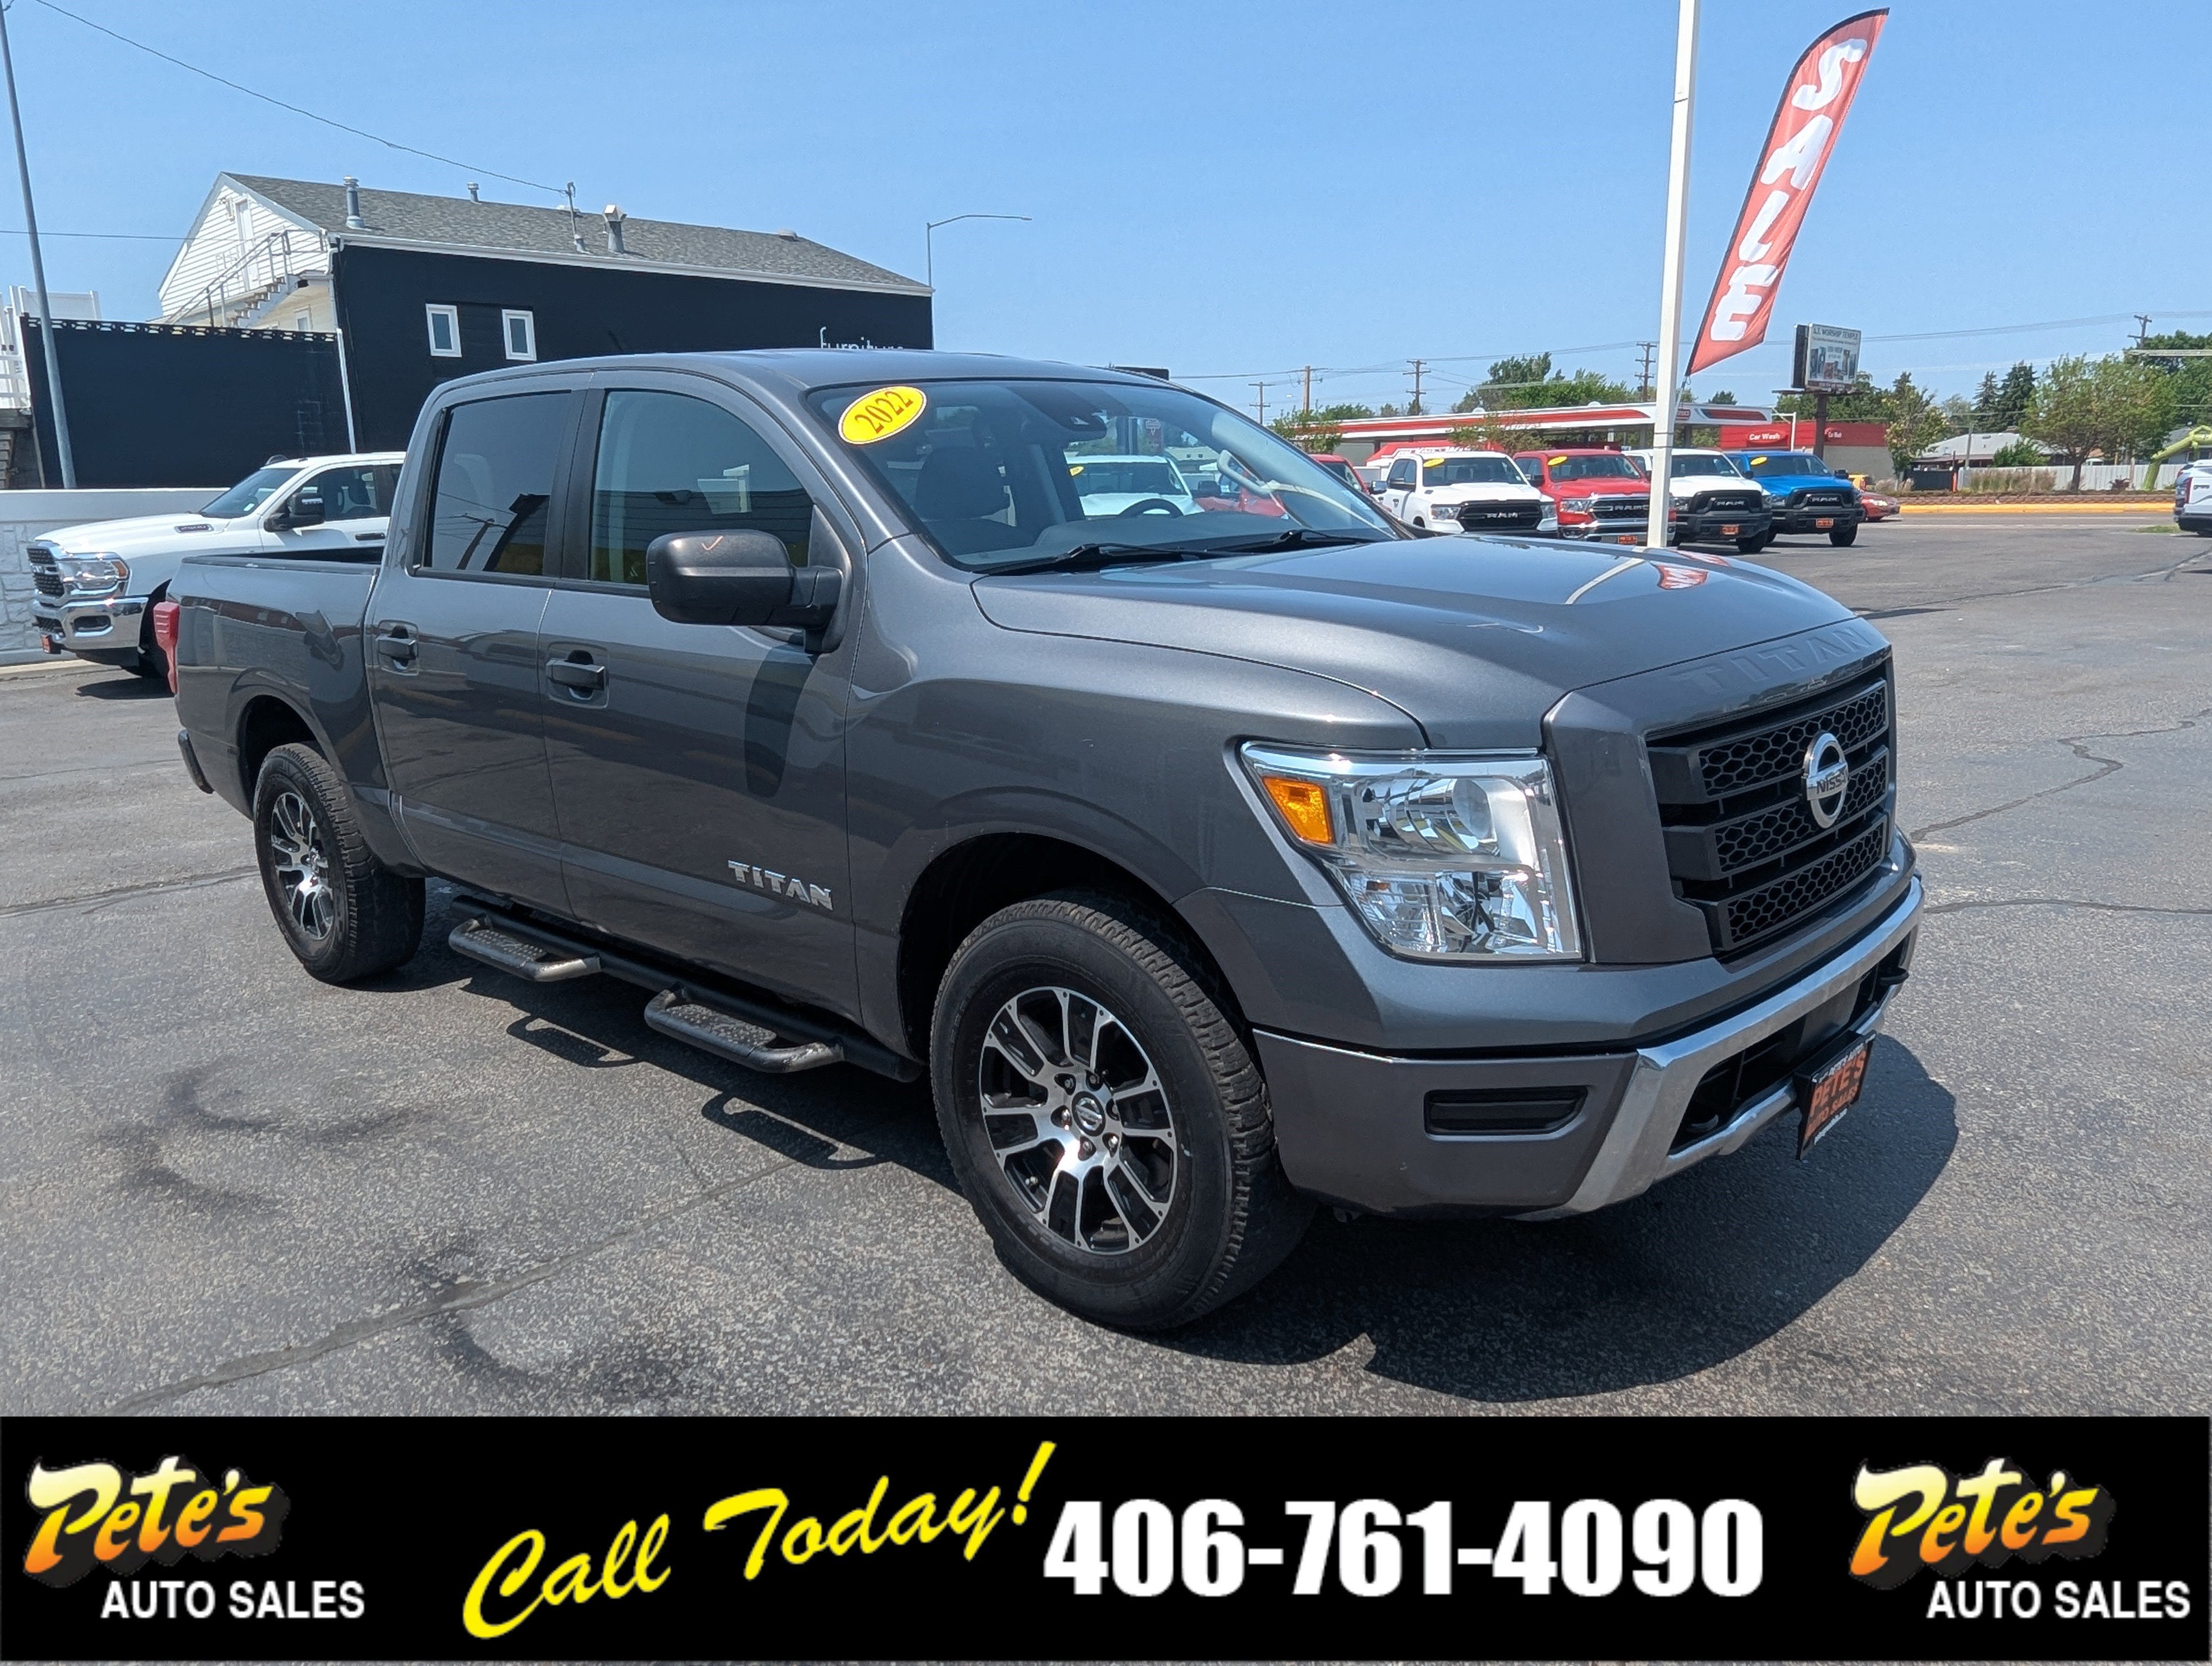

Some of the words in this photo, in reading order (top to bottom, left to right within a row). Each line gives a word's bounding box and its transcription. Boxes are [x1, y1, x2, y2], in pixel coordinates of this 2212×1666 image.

[1711, 39, 1867, 341] SALE
[820, 326, 904, 350] furnit
[854, 391, 914, 434] 2022
[1668, 626, 1873, 696] TITAN
[1816, 768, 1846, 794] NISS
[728, 860, 834, 911] TITAN
